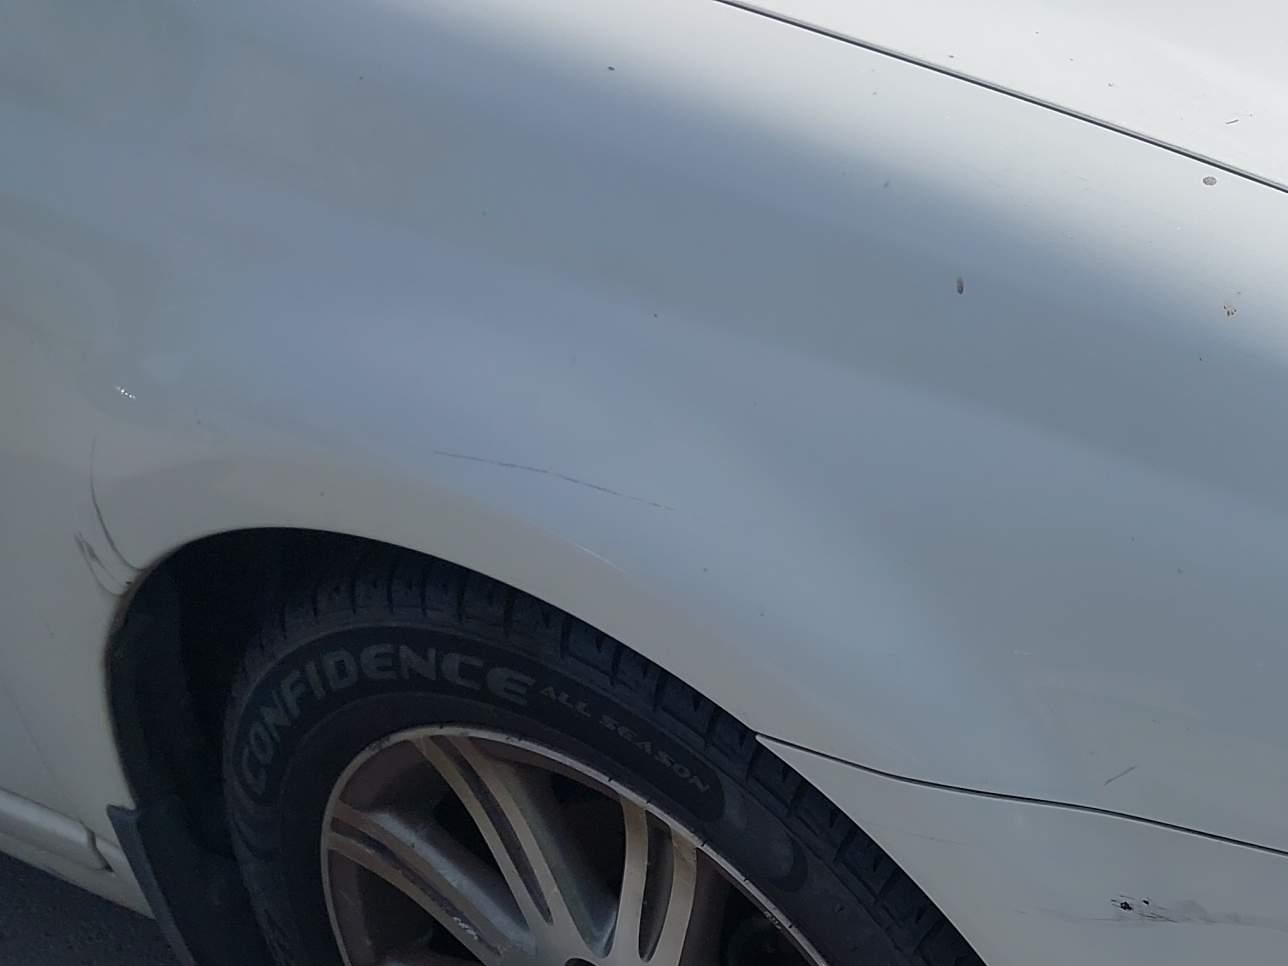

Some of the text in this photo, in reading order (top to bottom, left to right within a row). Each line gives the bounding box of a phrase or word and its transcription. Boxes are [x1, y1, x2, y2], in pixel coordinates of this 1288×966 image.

[240, 643, 536, 796] CONFIDENCE
[539, 685, 711, 794] ALL SEASON
